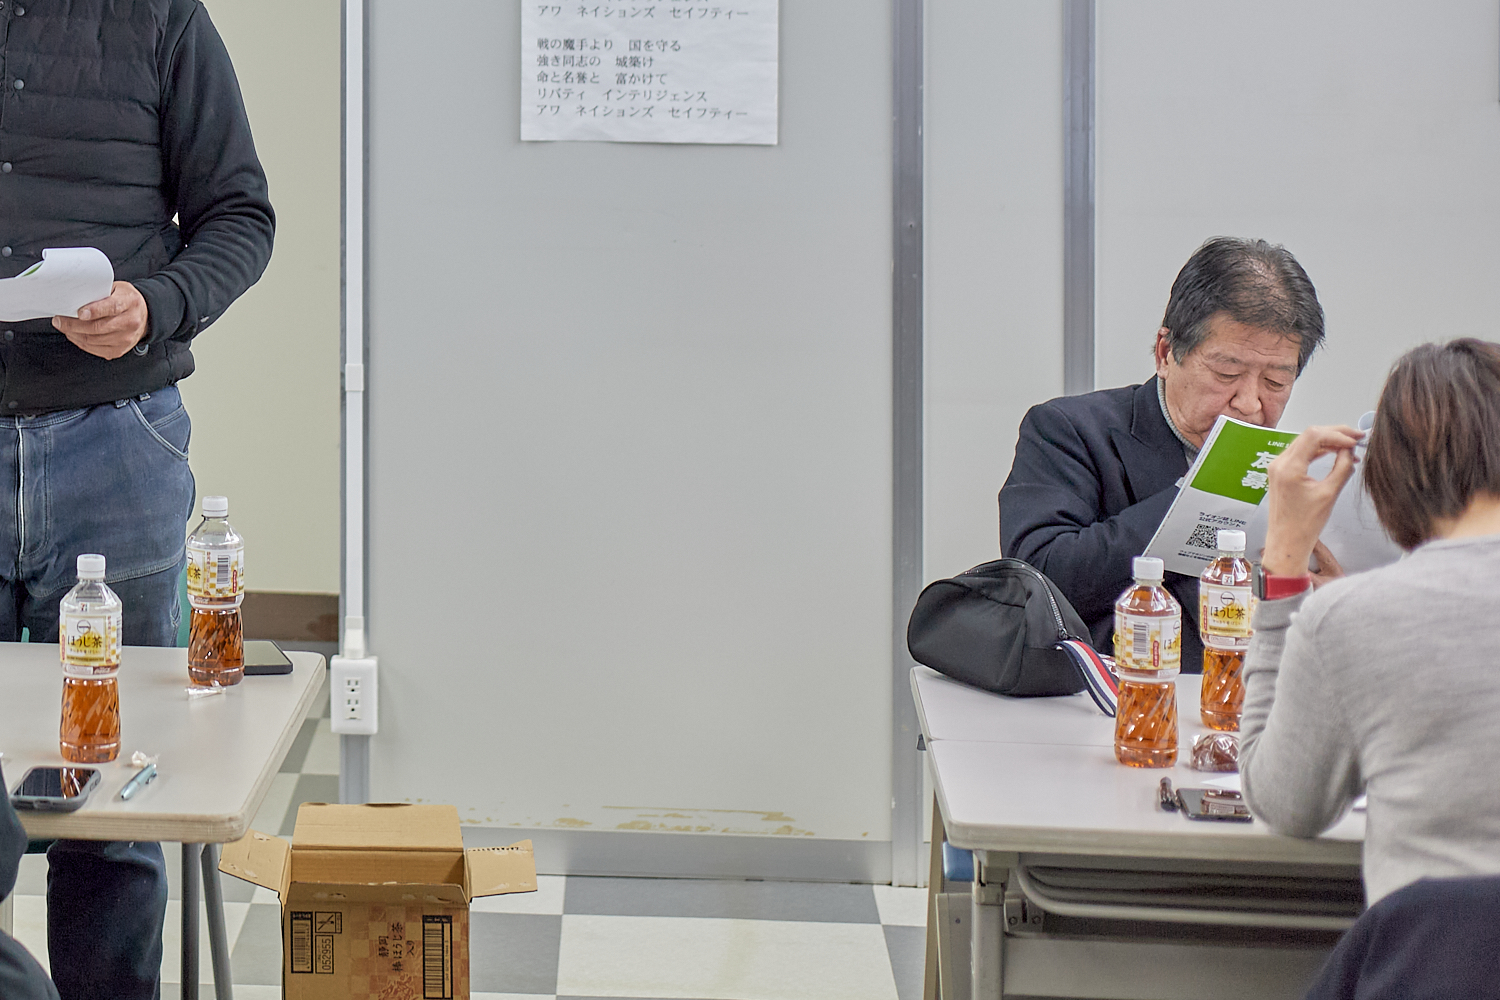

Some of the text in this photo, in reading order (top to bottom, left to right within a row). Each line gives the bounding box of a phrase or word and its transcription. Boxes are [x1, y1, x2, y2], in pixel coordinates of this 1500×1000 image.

[537, 5, 749, 20] アワ ネイションズ セイフティー
[536, 37, 682, 53] 戦の魔手より 国を守る
[536, 53, 601, 68] 強き同志の
[536, 70, 668, 86] 命と名誉と 富かけて
[538, 87, 707, 103] リバティ インテリジェンス
[536, 104, 748, 120] アワ ネイションズ セイフティー
[1210, 606, 1246, 620] ほうじ茶
[67, 634, 103, 649] ほうじ茶
[321, 938, 332, 971] 052955
